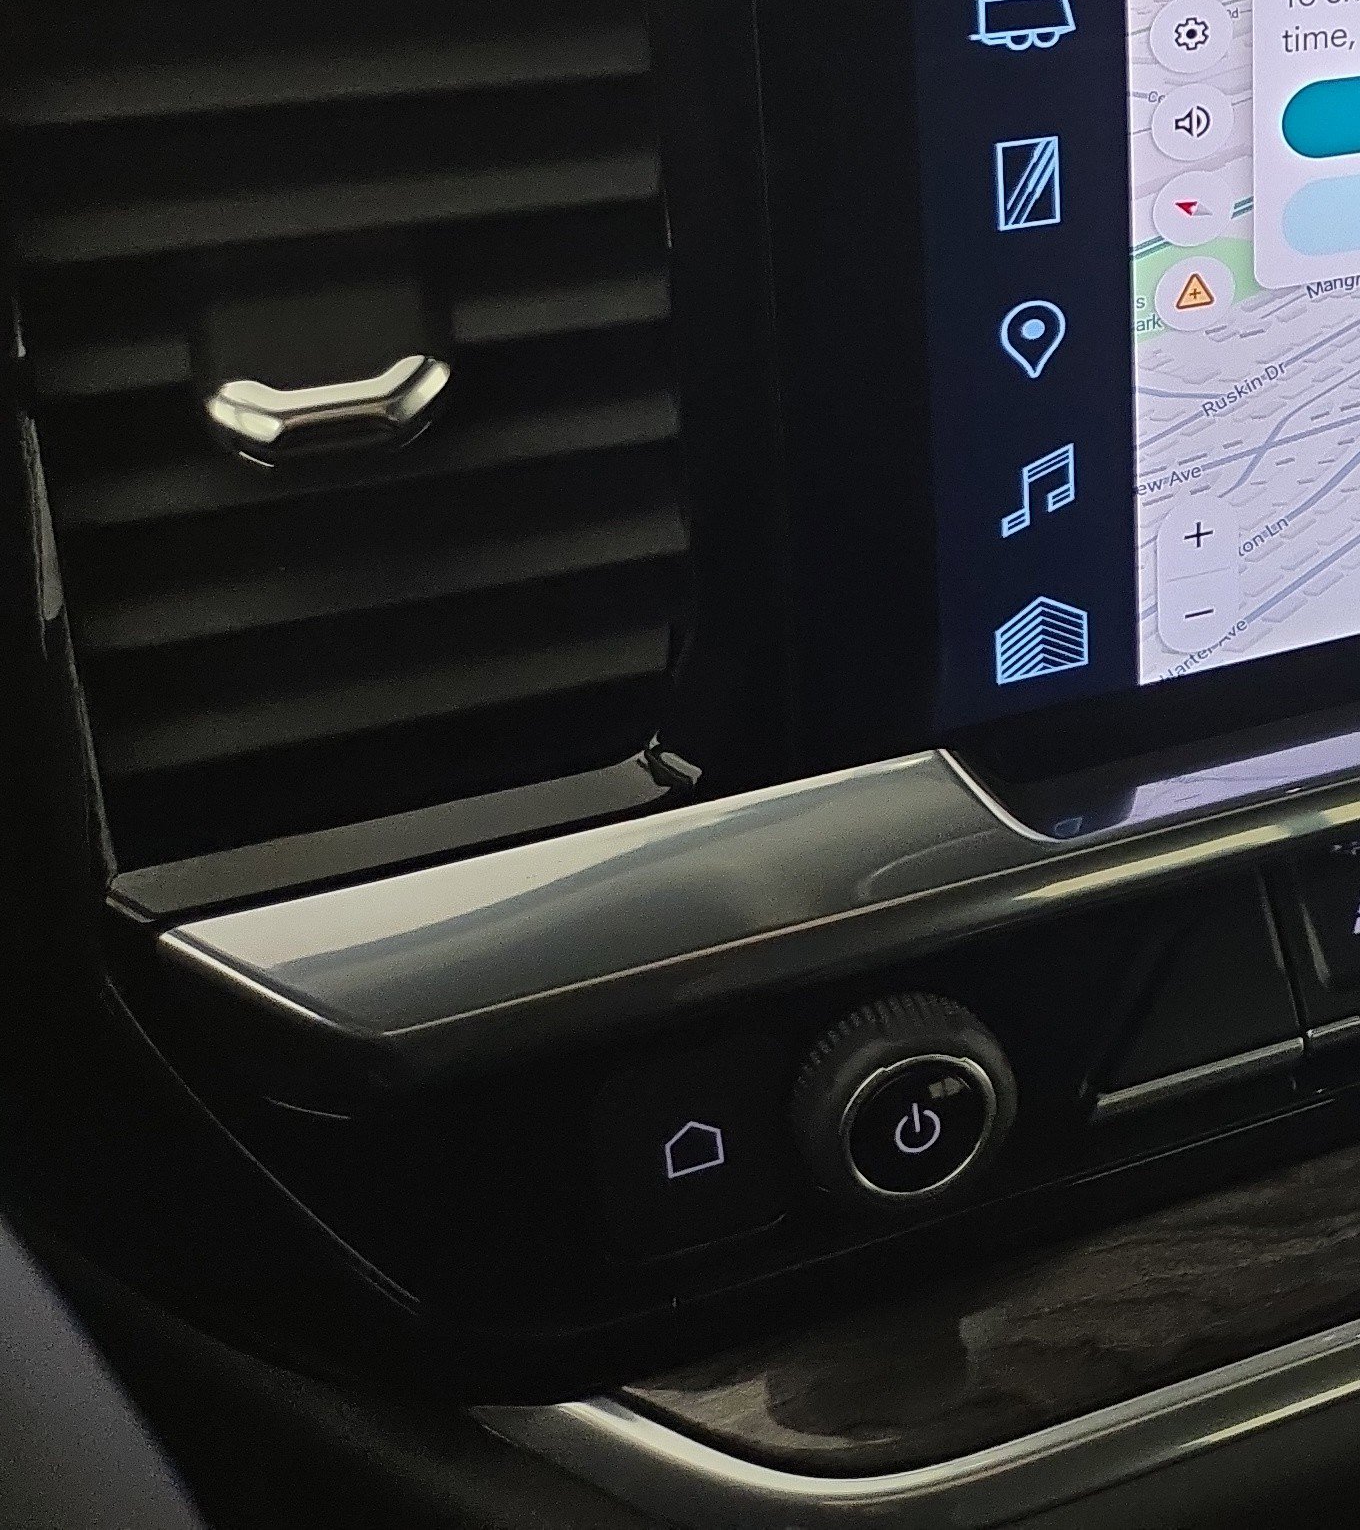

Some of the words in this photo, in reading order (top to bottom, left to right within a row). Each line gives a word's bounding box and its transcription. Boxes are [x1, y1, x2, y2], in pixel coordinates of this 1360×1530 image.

[1283, 23, 1355, 53] time,
[1201, 373, 1265, 417] Ruskin
[1264, 359, 1287, 387] Dr
[1169, 465, 1203, 486] Ave
[1266, 517, 1289, 536] Ln
